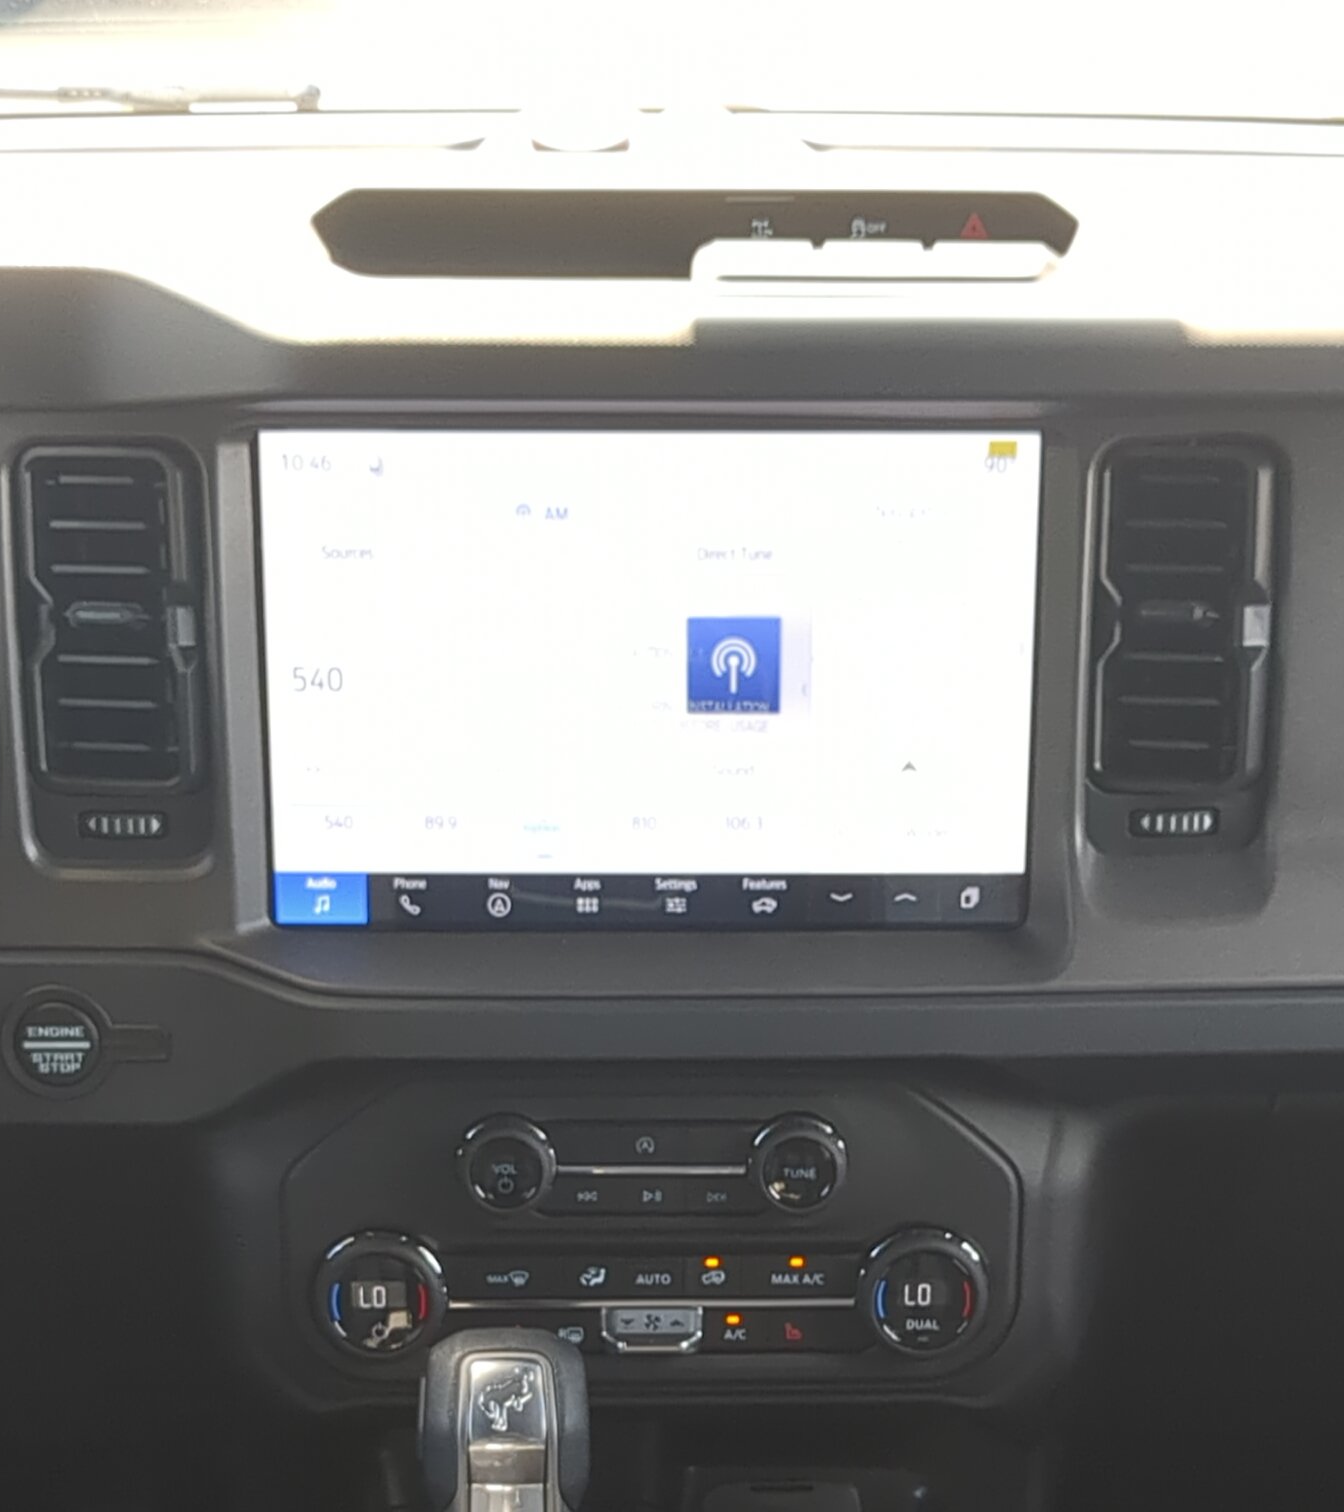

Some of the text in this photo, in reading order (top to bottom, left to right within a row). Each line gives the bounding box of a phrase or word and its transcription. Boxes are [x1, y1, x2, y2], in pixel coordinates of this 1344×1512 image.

[281, 453, 332, 472] 1046
[544, 506, 570, 521] AM
[292, 666, 344, 693] 540
[324, 815, 354, 830] 540
[424, 815, 458, 830] 899
[725, 815, 764, 830] 1061
[305, 877, 337, 890] Audio
[393, 877, 427, 890] Phone
[488, 878, 510, 890] Nav
[574, 878, 601, 892] Apps
[655, 877, 697, 892] Settings
[742, 877, 787, 890] Features
[26, 1025, 85, 1038] ENGINE
[31, 1052, 84, 1063] START
[39, 1062, 81, 1074] STOP
[492, 1163, 517, 1176] VOL
[782, 1167, 817, 1180] TUNE
[635, 1272, 671, 1286] AUTO
[771, 1273, 825, 1286] MAX A/C
[359, 1285, 386, 1309] LO
[904, 1283, 931, 1306] LO
[906, 1319, 939, 1331] DUAL
[723, 1328, 747, 1341] A/C
